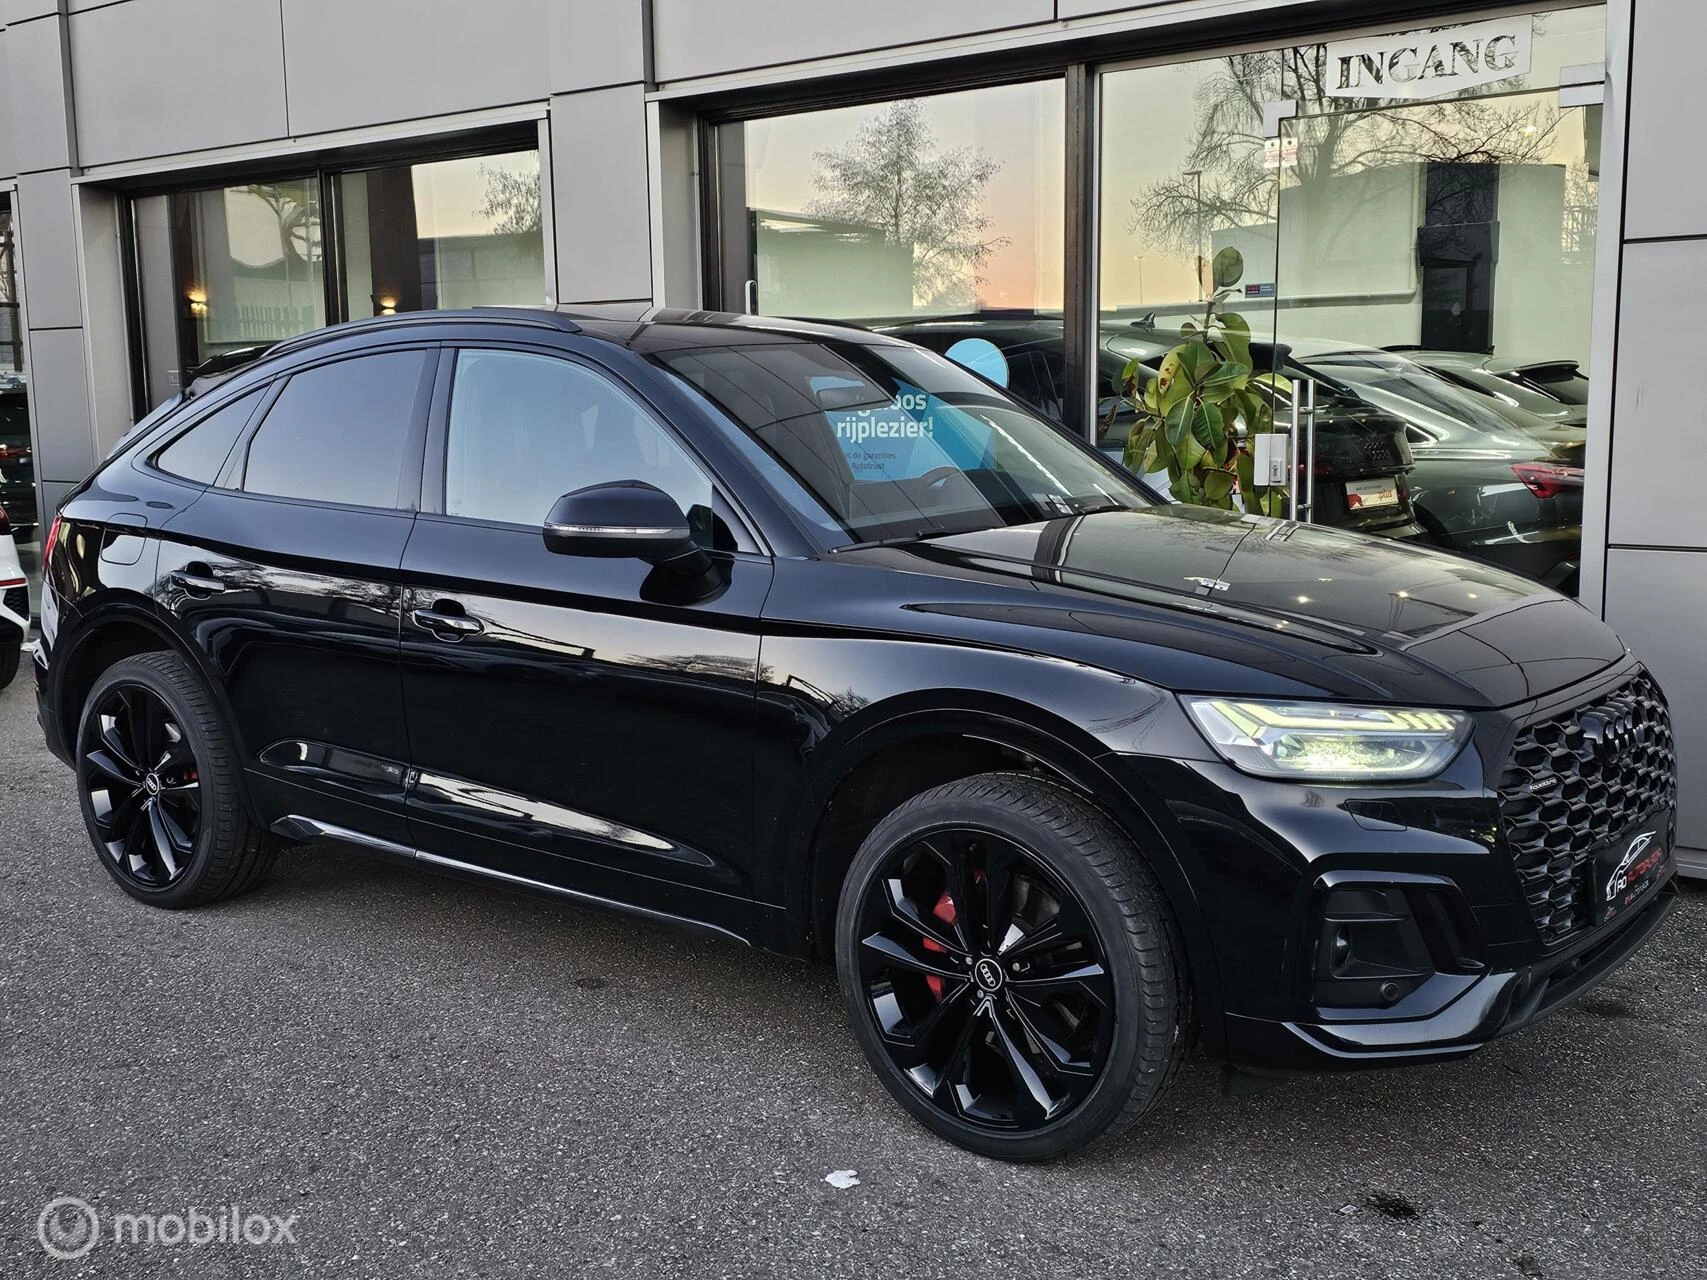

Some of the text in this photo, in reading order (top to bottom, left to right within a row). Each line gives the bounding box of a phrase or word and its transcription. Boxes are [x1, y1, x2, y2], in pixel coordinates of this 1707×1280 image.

[1335, 35, 1516, 89] INGANG
[836, 416, 933, 444] rijplezier!
[863, 451, 897, 461] garanties
